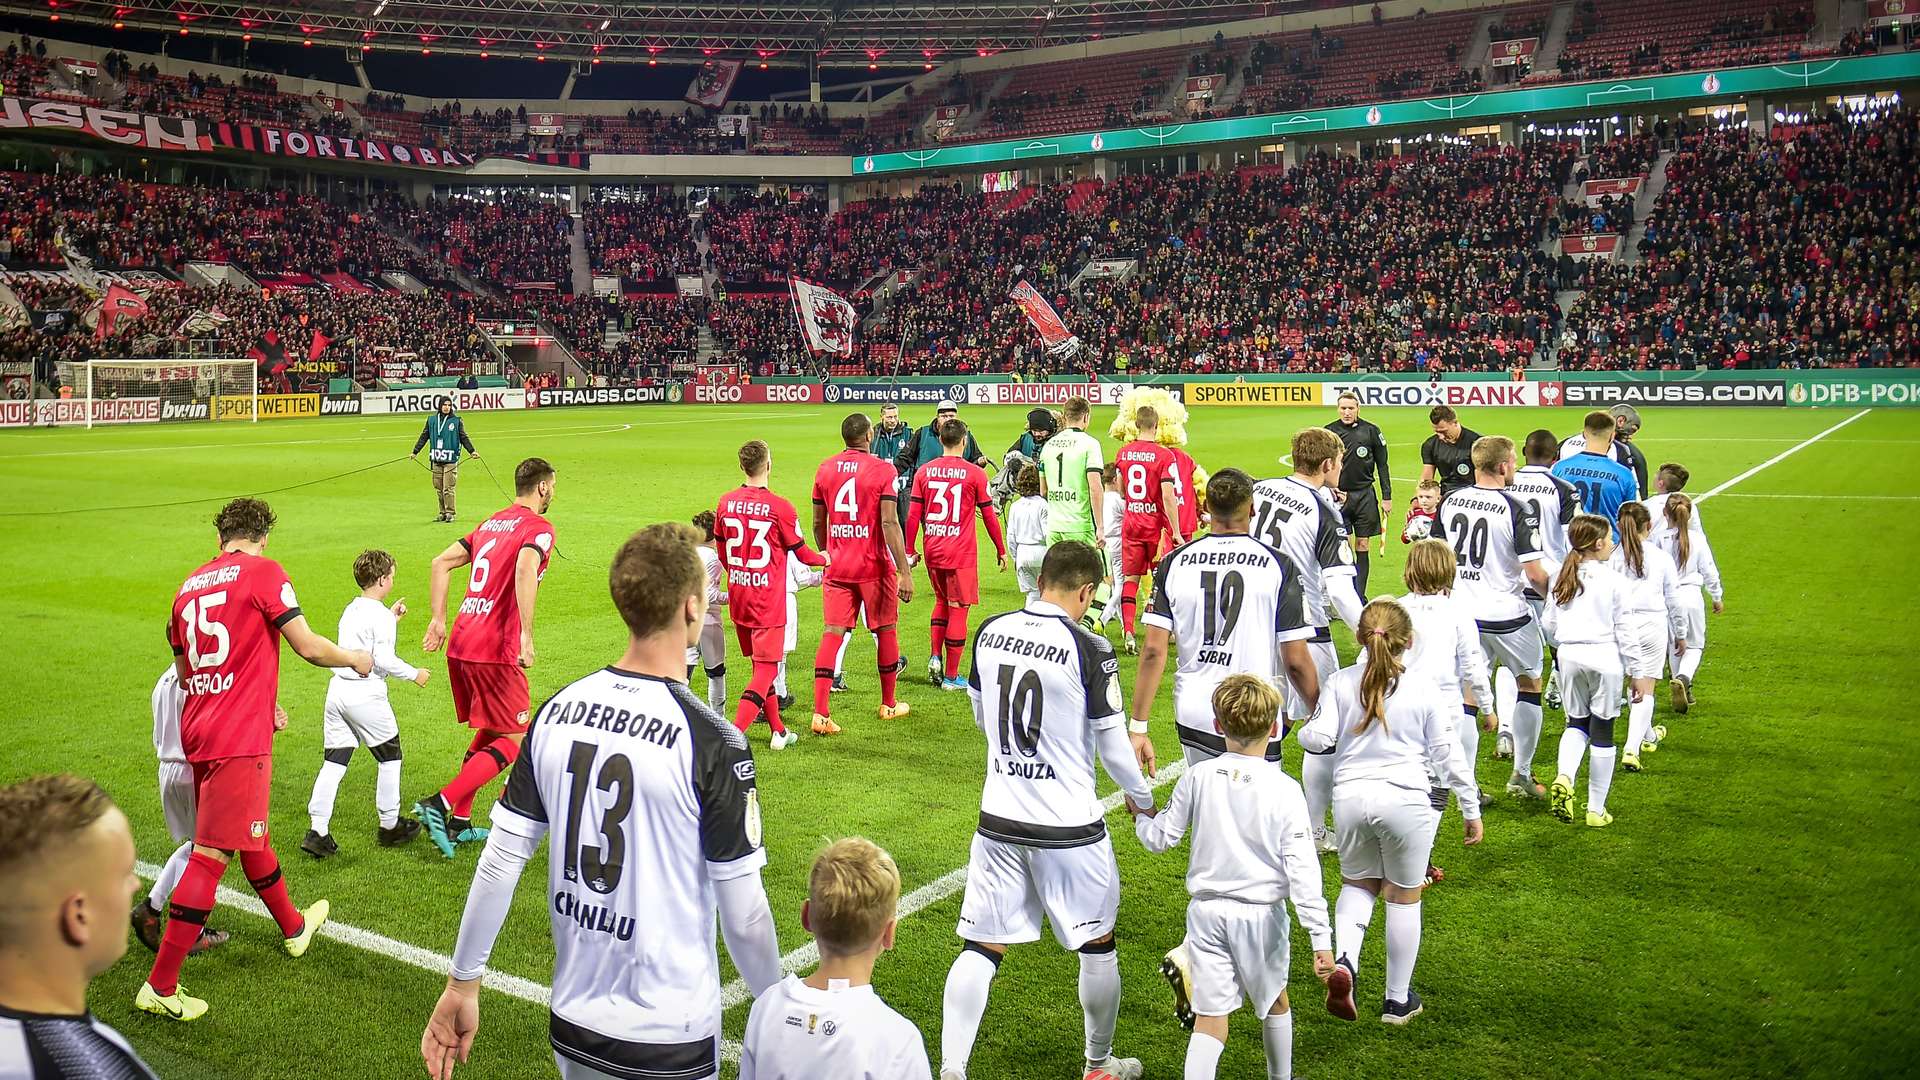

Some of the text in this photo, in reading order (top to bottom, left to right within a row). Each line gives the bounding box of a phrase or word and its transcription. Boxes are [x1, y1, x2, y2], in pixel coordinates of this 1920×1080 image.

[266, 129, 385, 160] FORZA
[540, 387, 664, 405] STRAUSS.COM
[696, 385, 741, 402] ERGO
[766, 385, 810, 402] ERGO
[844, 388, 945, 401] Der neue Passat
[999, 386, 1100, 401] BAUHAUS
[1195, 386, 1311, 402] SPORTWETTEN
[1566, 386, 1783, 402] STRAUSS.COM
[57, 402, 158, 420] BAUHAUS
[162, 400, 207, 418] bwin
[322, 396, 359, 414] bwin
[430, 449, 454, 460] HOST
[1127, 452, 1156, 462] BENDER
[837, 461, 858, 473] TAH
[926, 467, 966, 480] VOLLAND
[1056, 452, 1063, 487] 1
[1565, 467, 1618, 481] PADERBORN
[1128, 464, 1147, 500] 8
[1504, 483, 1557, 496] ADERBORN
[834, 477, 858, 522] 4
[926, 480, 963, 523] 31
[1064, 491, 1076, 502] 04
[1252, 486, 1313, 516] PADERBORN
[727, 500, 770, 517] WEISER
[1144, 503, 1157, 513] 04
[1447, 497, 1506, 515] PADERBORN
[830, 525, 869, 539] AYER 04
[947, 525, 960, 537] 04
[1254, 500, 1293, 549] 15
[723, 517, 772, 570] 23
[1450, 513, 1488, 569] 20
[469, 537, 497, 593] 6
[1180, 552, 1269, 568] PADERBORN
[752, 571, 769, 587] 04
[476, 597, 494, 616] 04
[1200, 569, 1245, 647] 19
[180, 590, 231, 671] 15
[979, 632, 1070, 665] PADERBORN
[1197, 650, 1232, 667] SIBRI
[209, 672, 234, 694] 04
[997, 663, 1043, 758] 10
[544, 700, 683, 750] PADERBORN
[1007, 760, 1056, 780] SOUZA
[563, 739, 634, 895] 13
